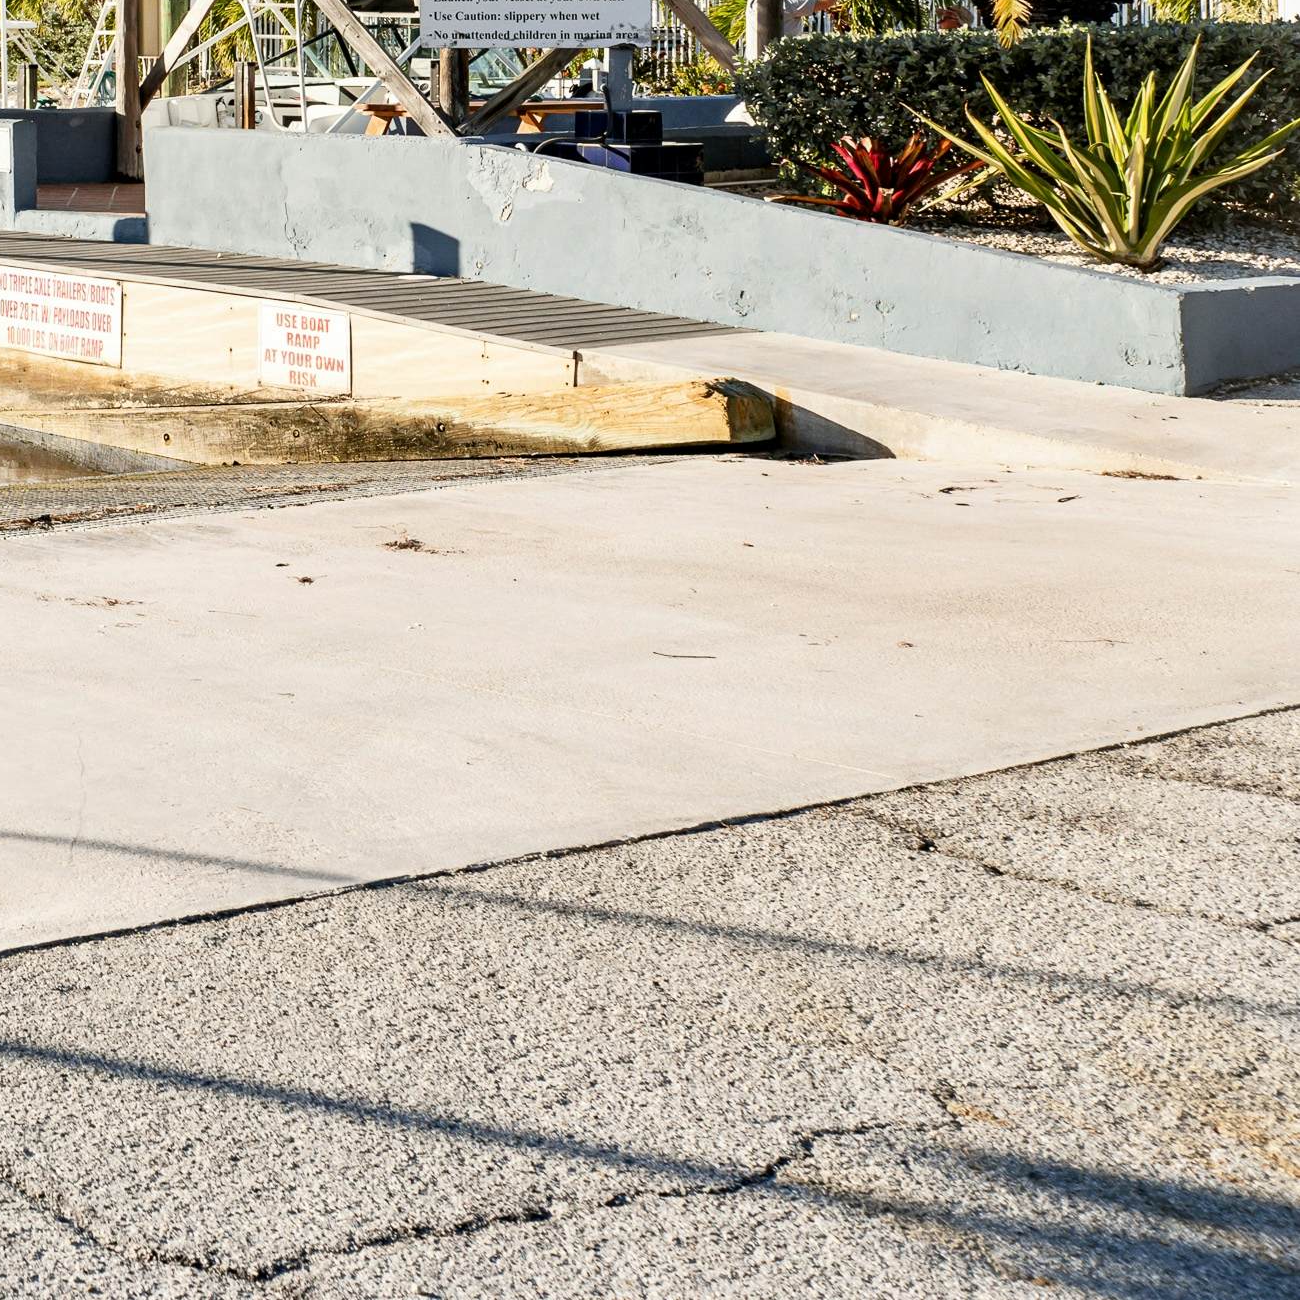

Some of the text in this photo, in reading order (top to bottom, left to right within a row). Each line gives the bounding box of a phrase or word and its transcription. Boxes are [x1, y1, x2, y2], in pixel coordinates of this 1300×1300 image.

[434, 11, 600, 23] Use Caution: slippery when wet
[434, 30, 639, 40] No unattended children in marina area
[9, 274, 33, 294] TRIPLE
[34, 276, 51, 297] AXLE
[0, 299, 18, 319] OVER
[53, 307, 90, 330] PAYLOADS
[92, 312, 112, 333] OVER
[276, 312, 330, 333] USE BOAT
[49, 332, 58, 352] ON
[60, 334, 79, 355] BOAT
[80, 336, 103, 358] RAMP
[286, 332, 320, 350] RAMP
[264, 348, 344, 373] AT YOUR OWN
[289, 370, 317, 387] RISK
